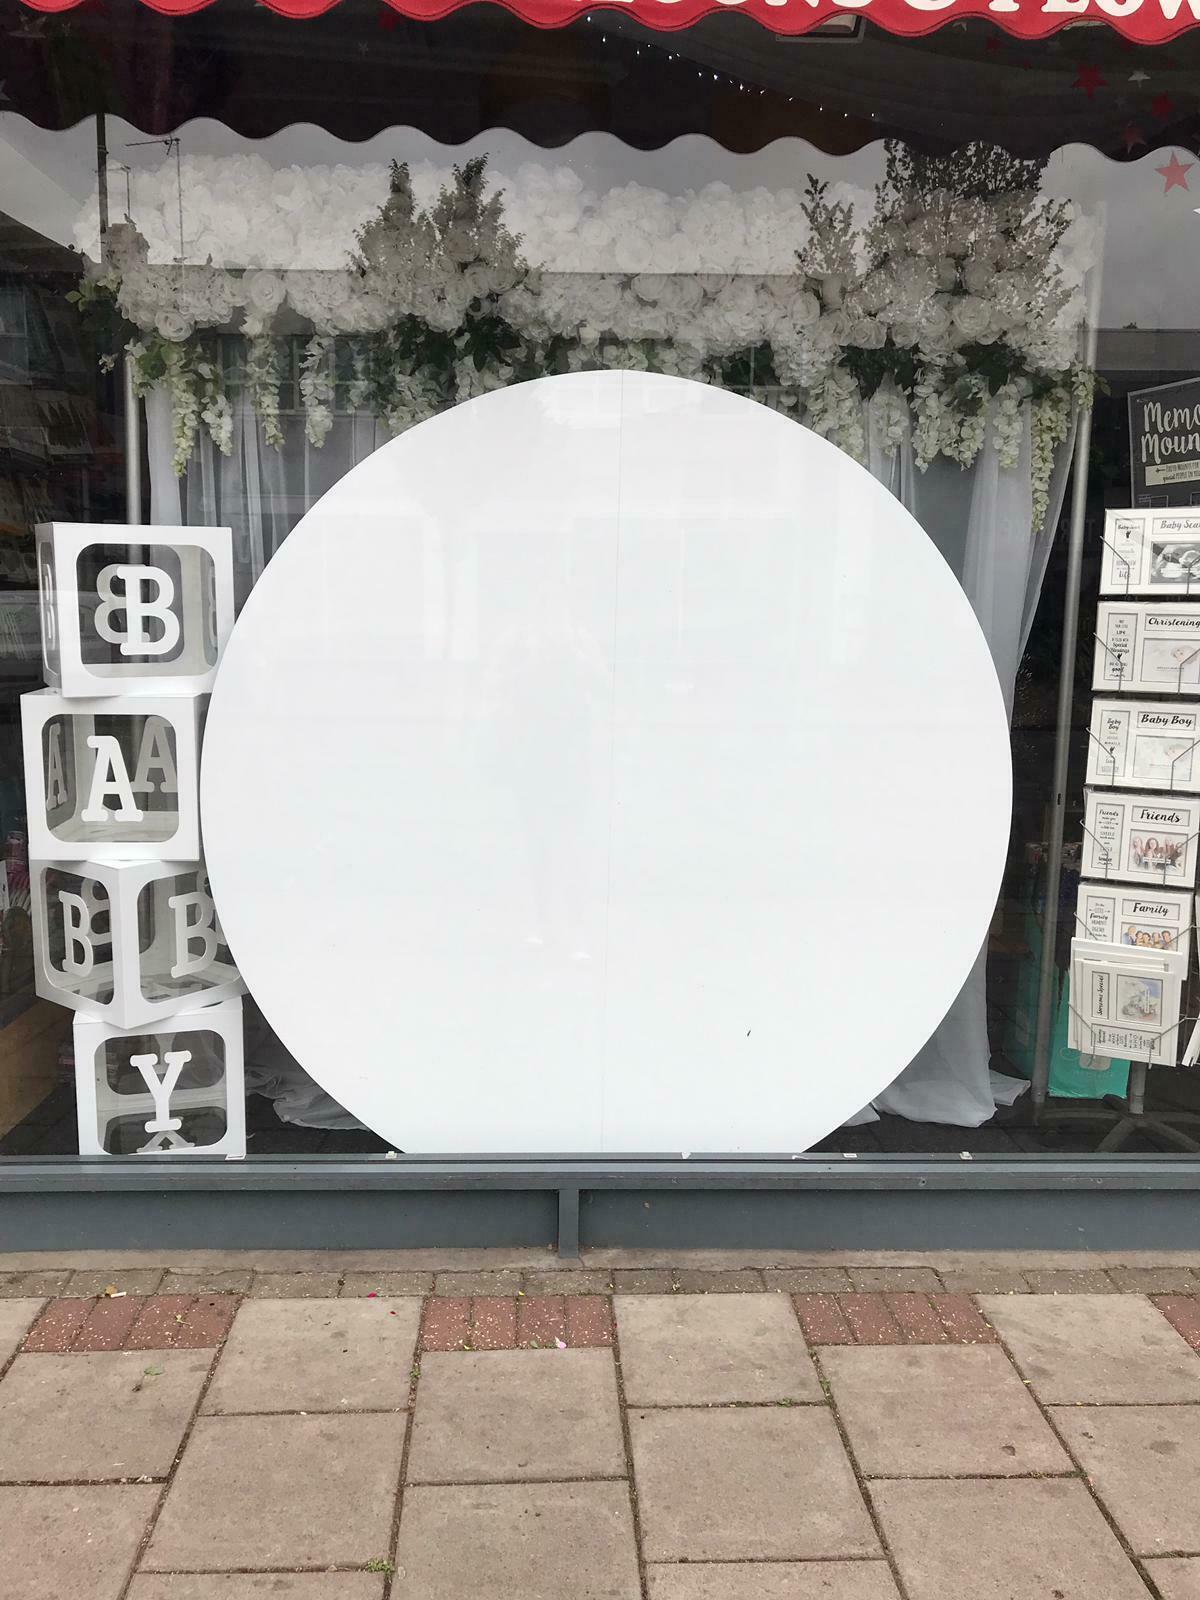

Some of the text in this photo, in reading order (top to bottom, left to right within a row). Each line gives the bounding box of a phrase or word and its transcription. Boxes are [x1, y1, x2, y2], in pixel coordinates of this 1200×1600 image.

[1160, 520, 1182, 531] Baby
[116, 565, 180, 656] B
[1148, 616, 1200, 628] Christening
[1141, 713, 1192, 728] Baby Boy
[80, 735, 144, 822] A
[1140, 809, 1182, 823] Friends
[58, 890, 94, 978] B
[1133, 902, 1169, 917] Family
[168, 891, 218, 979] B
[129, 1050, 192, 1133] Y
